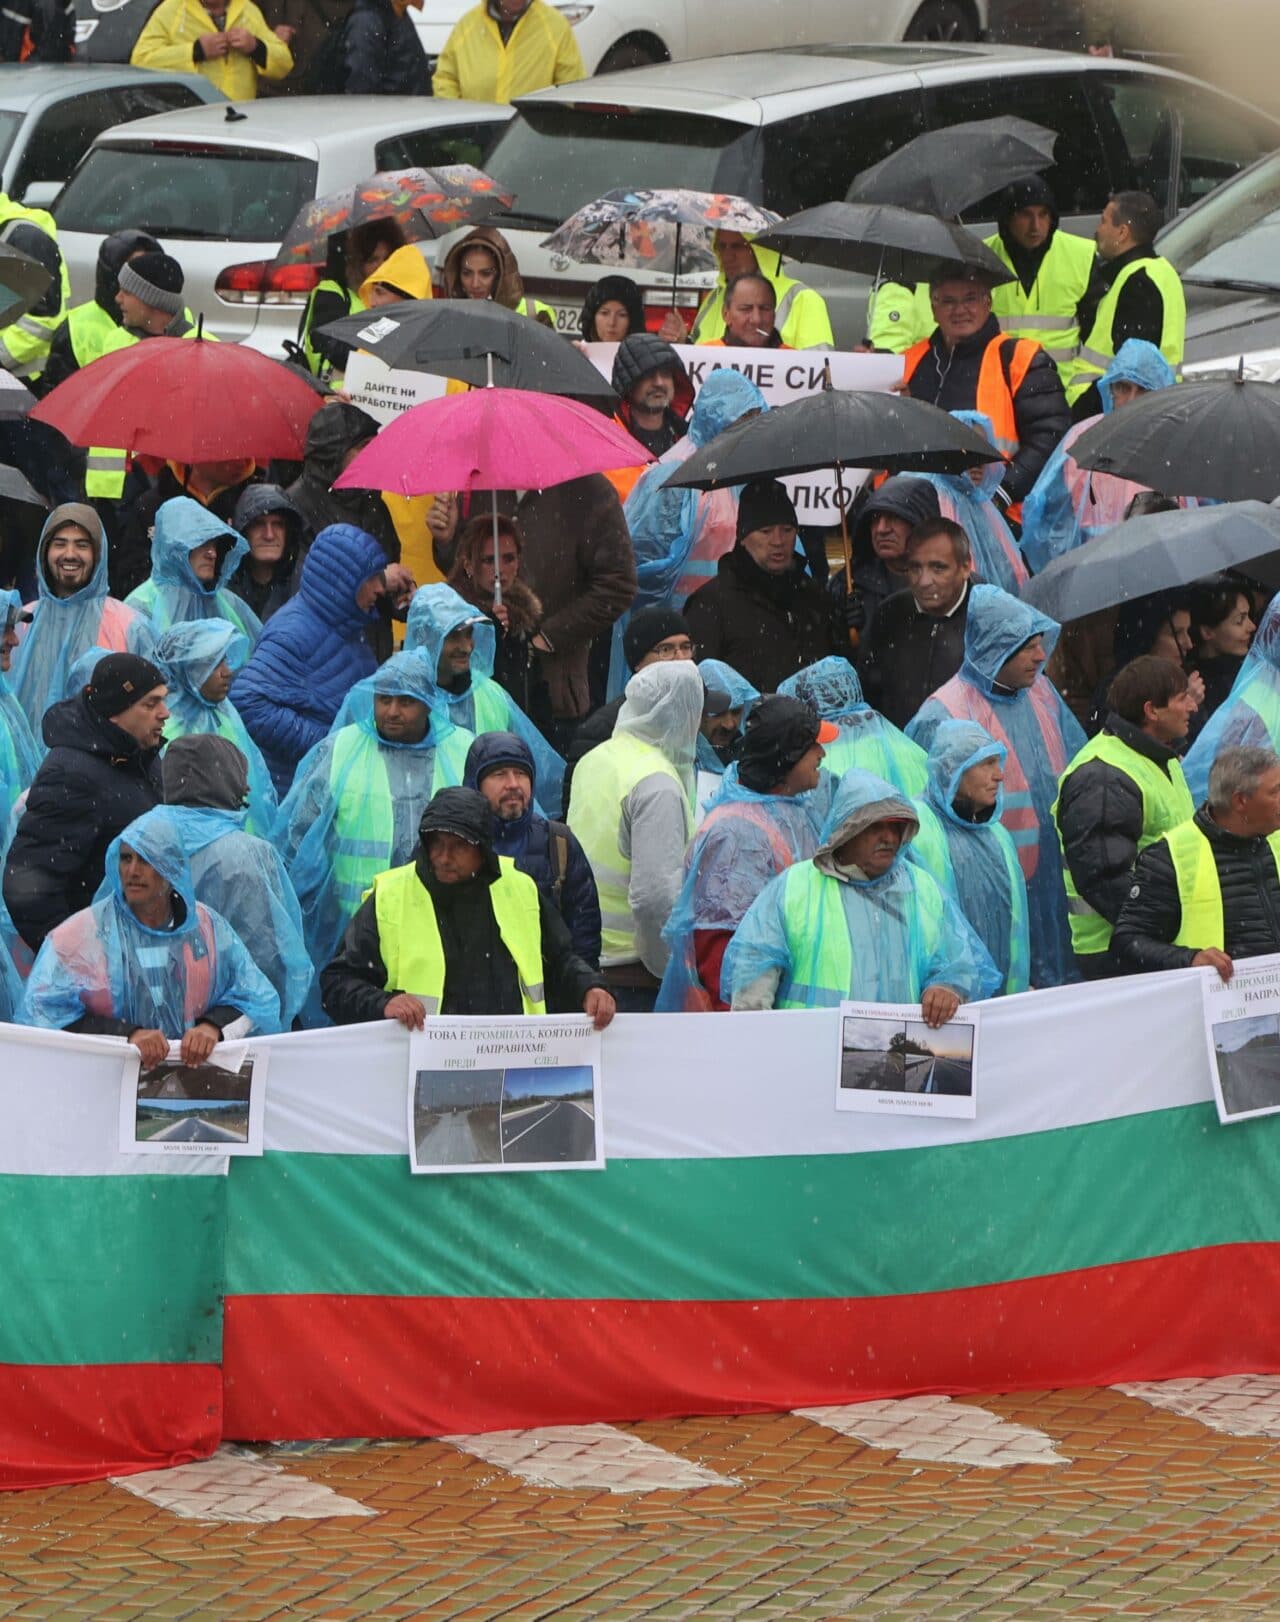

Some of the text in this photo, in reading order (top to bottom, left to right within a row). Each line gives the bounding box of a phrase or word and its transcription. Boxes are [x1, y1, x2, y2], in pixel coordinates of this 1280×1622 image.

[785, 365, 827, 390] СИ
[400, 388, 416, 398] НИ
[428, 1030, 457, 1041] ТОВА
[460, 1030, 467, 1041] Е
[538, 1028, 573, 1039] КОЯТО
[476, 1043, 546, 1055] НАПРАВИХМЕ
[444, 1058, 476, 1068] ПРЕДИ
[534, 1056, 559, 1066] СЛЕД
